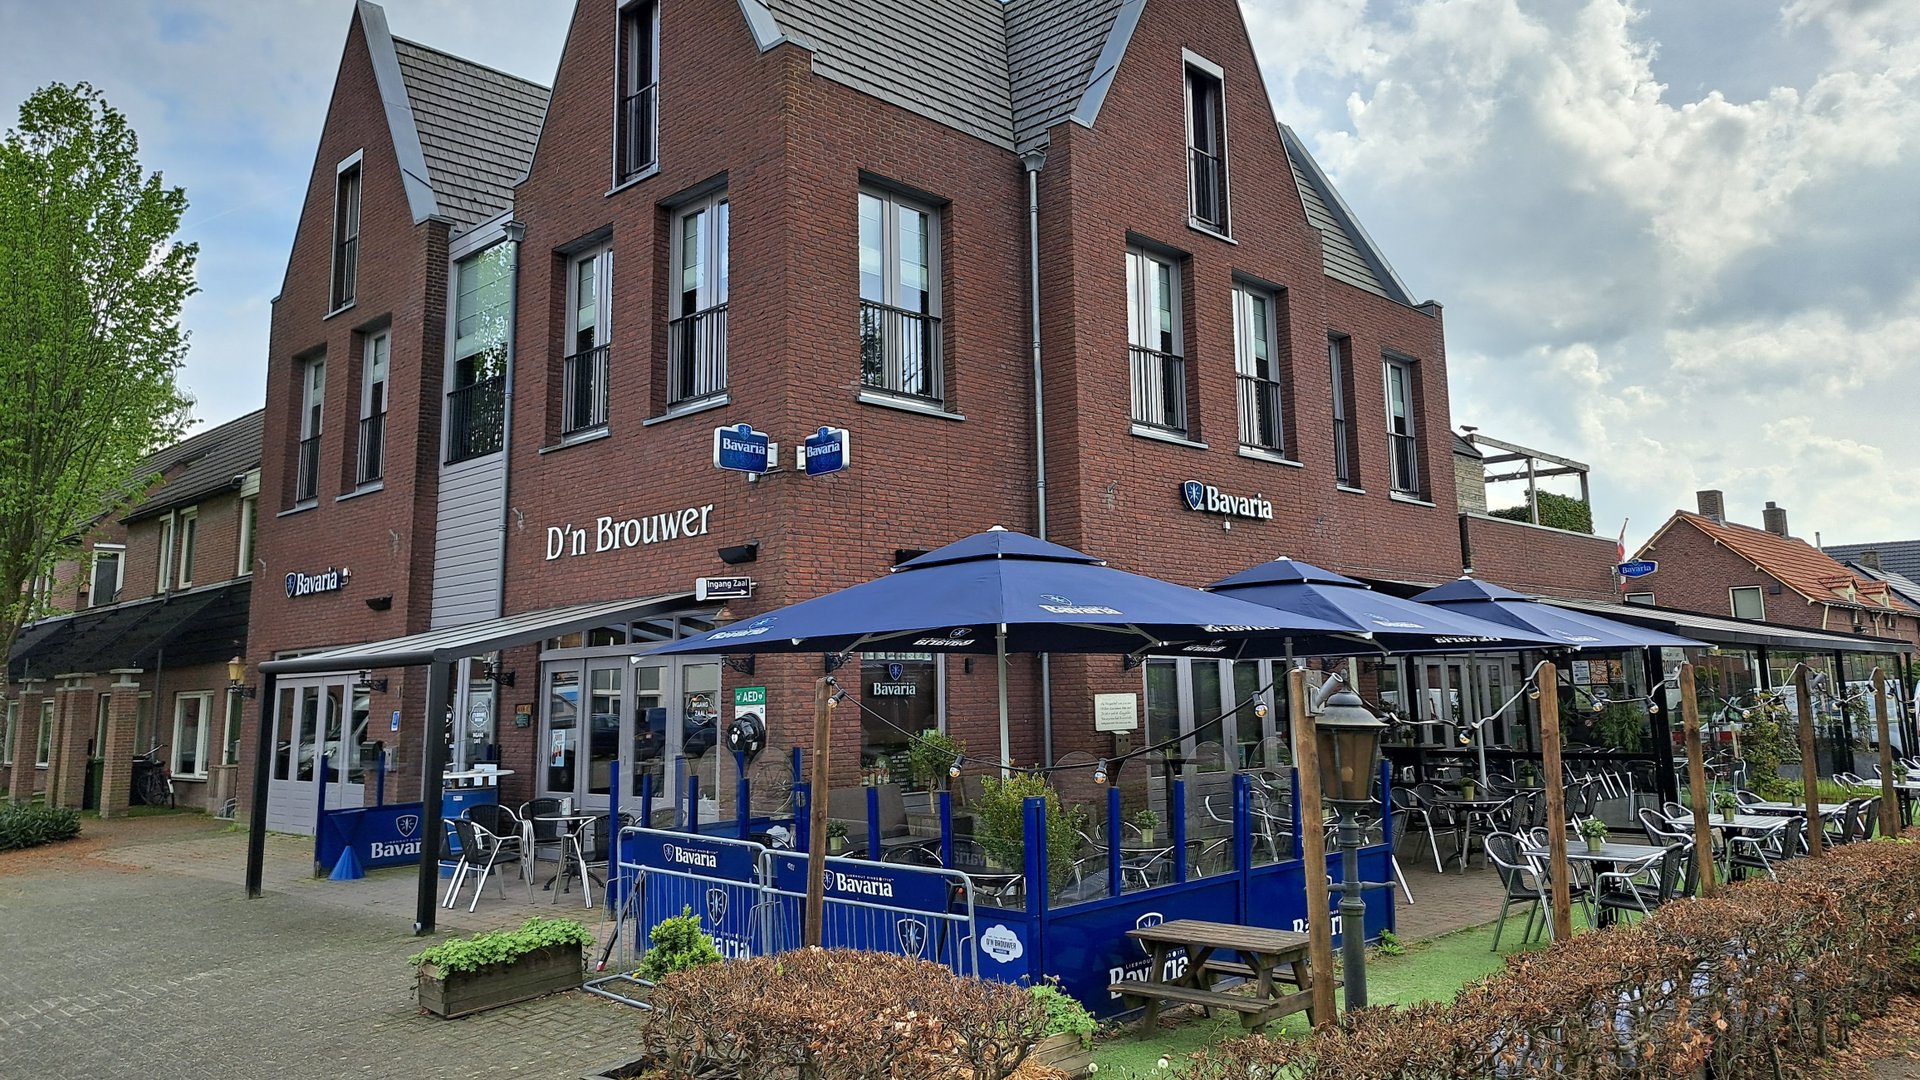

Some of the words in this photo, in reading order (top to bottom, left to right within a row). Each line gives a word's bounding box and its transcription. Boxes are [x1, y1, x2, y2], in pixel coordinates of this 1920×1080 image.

[722, 437, 766, 455] Bavaria
[806, 442, 841, 458] Bavaria
[1205, 485, 1274, 519] Bavaria
[545, 523, 587, 561] D'n
[595, 503, 714, 553] Brouwer
[1622, 564, 1652, 574] Bavaria
[294, 571, 338, 597] Bavaria
[707, 580, 732, 590] Ingang
[733, 578, 748, 588] Zaal
[742, 690, 758, 702] AED
[873, 682, 916, 696] Bavaria
[371, 842, 422, 859] Bavar
[675, 846, 717, 868] Bavaria
[836, 872, 894, 898] Bavaria
